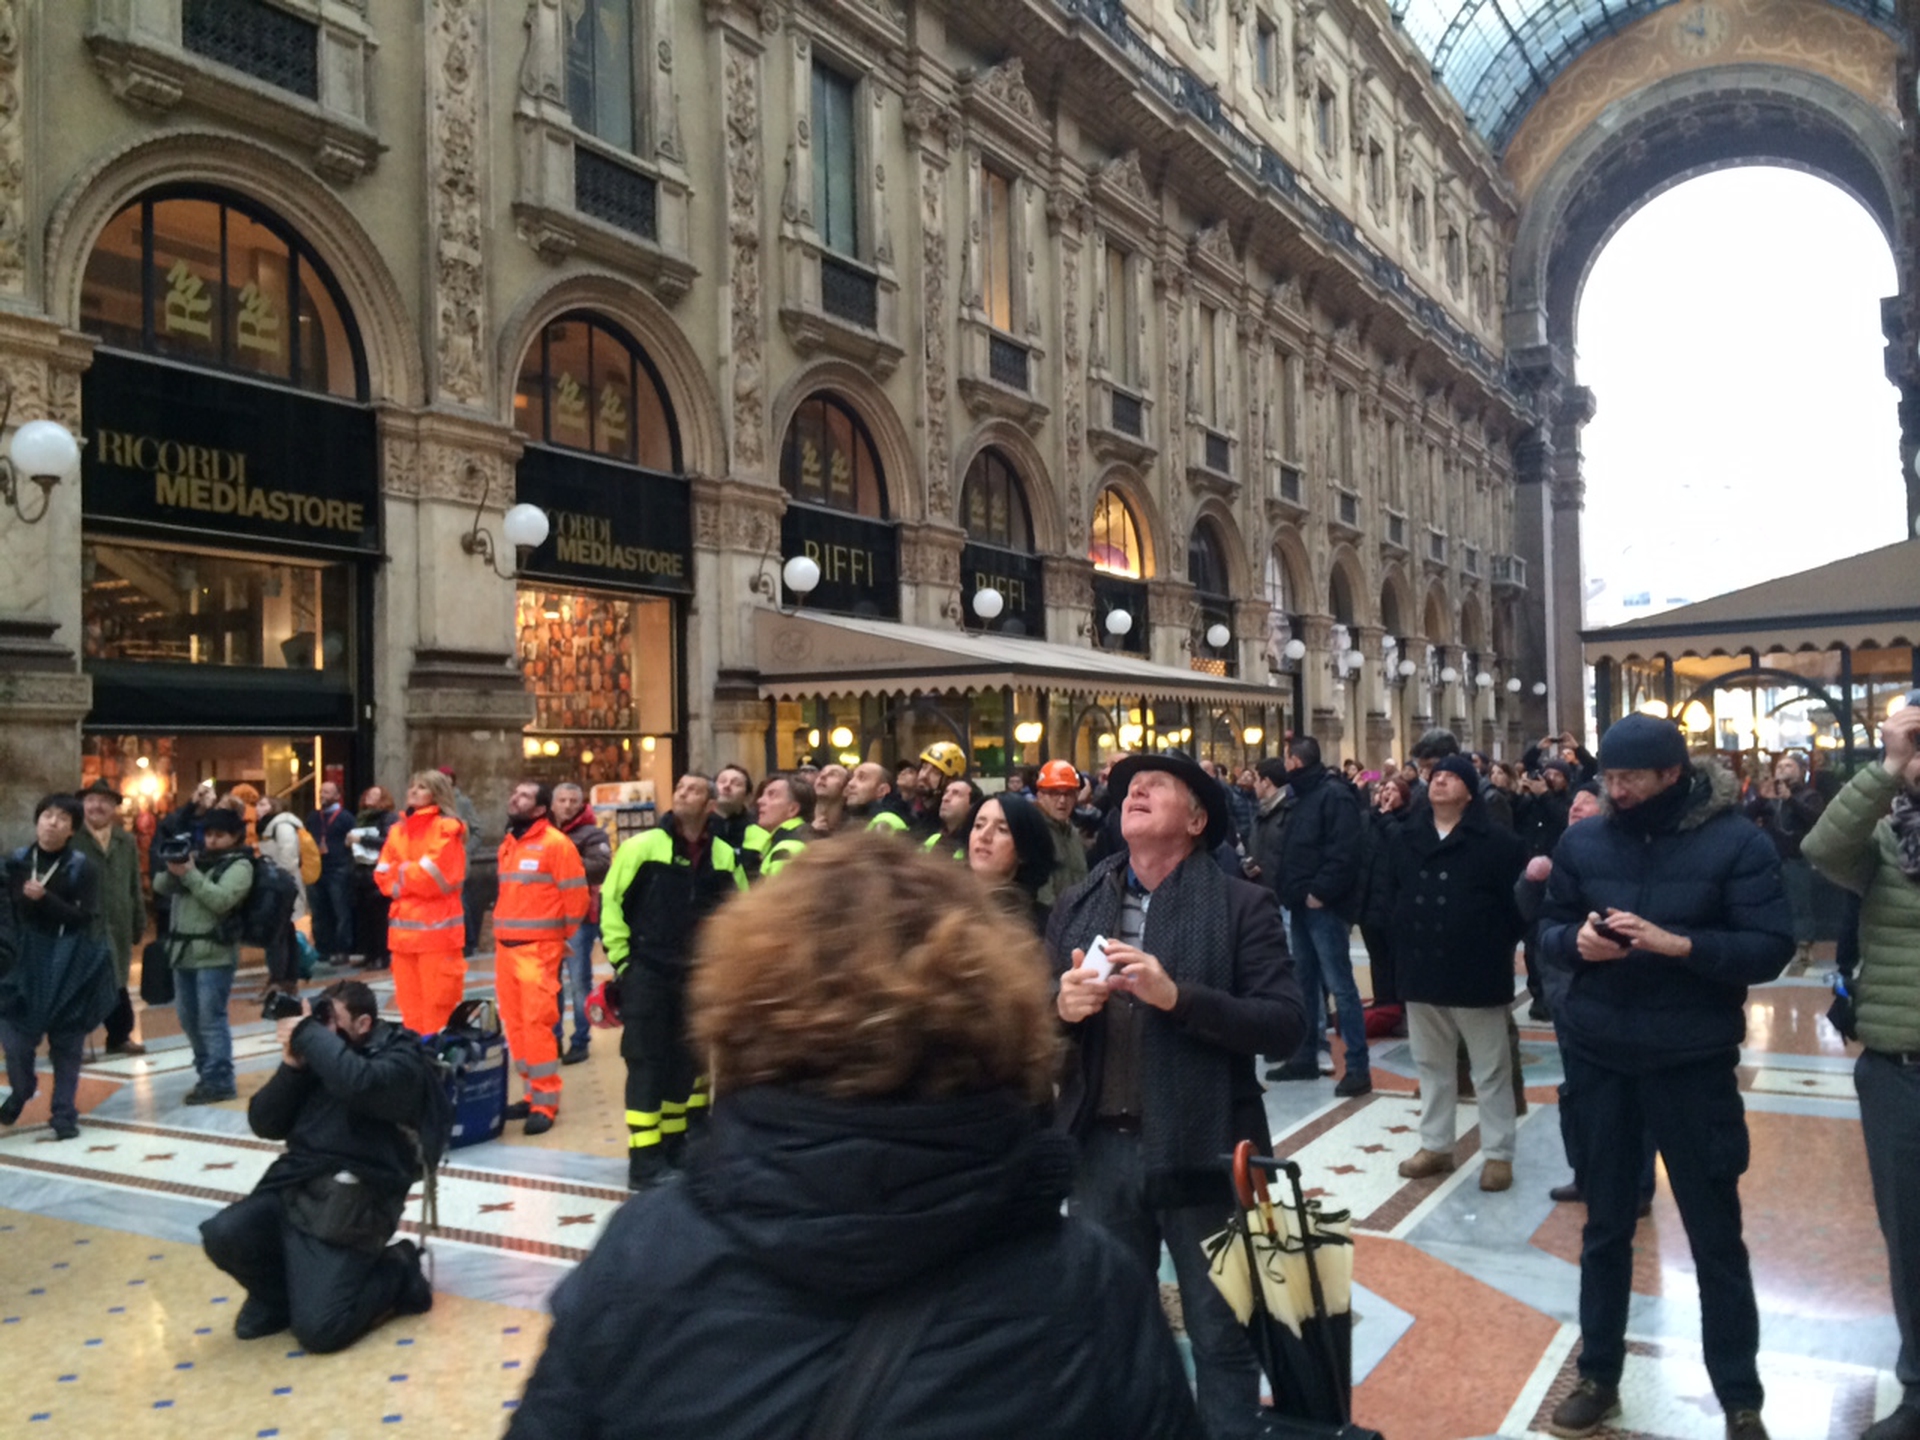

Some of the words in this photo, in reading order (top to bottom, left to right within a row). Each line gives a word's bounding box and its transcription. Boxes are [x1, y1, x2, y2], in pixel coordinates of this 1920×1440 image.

[97, 429, 248, 484] RICORDI
[155, 472, 365, 533] MEDIASTORE
[546, 508, 611, 547] ORDI
[557, 537, 684, 577] MEDIASTORE
[804, 540, 874, 588] BIFFI
